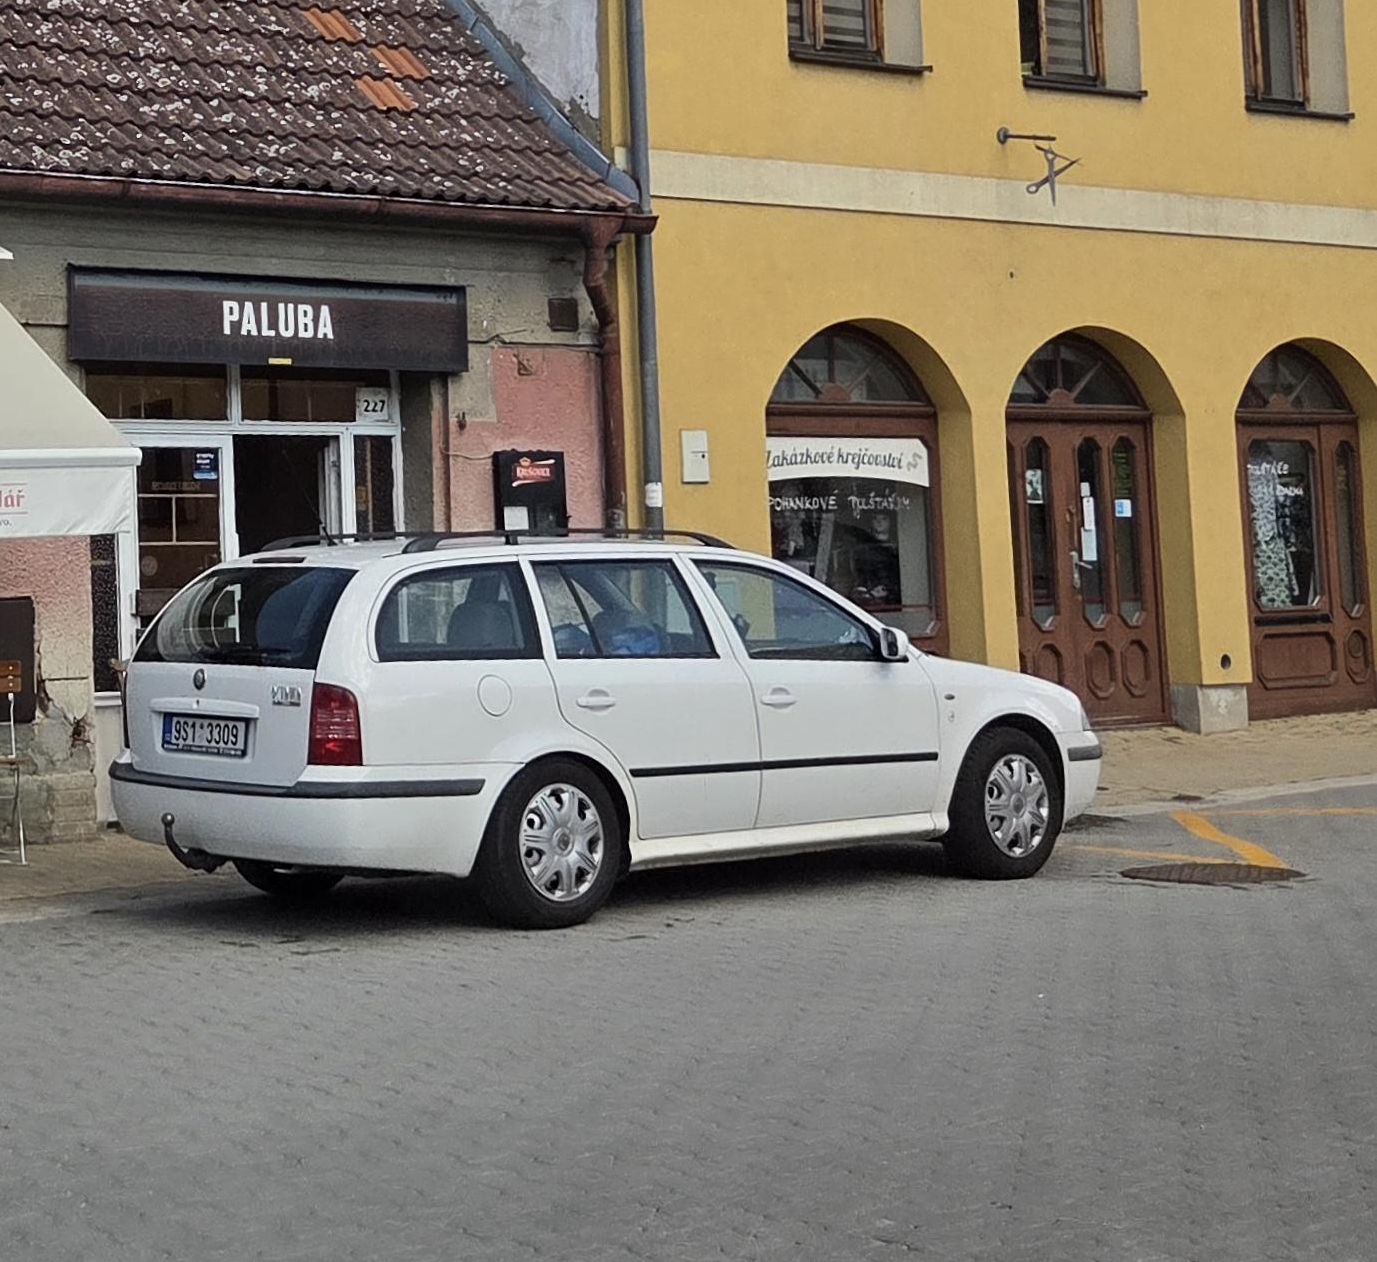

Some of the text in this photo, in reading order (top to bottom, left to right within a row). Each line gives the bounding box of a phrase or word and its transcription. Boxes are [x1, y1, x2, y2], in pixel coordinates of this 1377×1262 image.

[222, 300, 334, 340] PALUBA
[363, 399, 386, 413] 227
[837, 446, 904, 470] krejčovství
[174, 719, 239, 747] 9S1 3309
